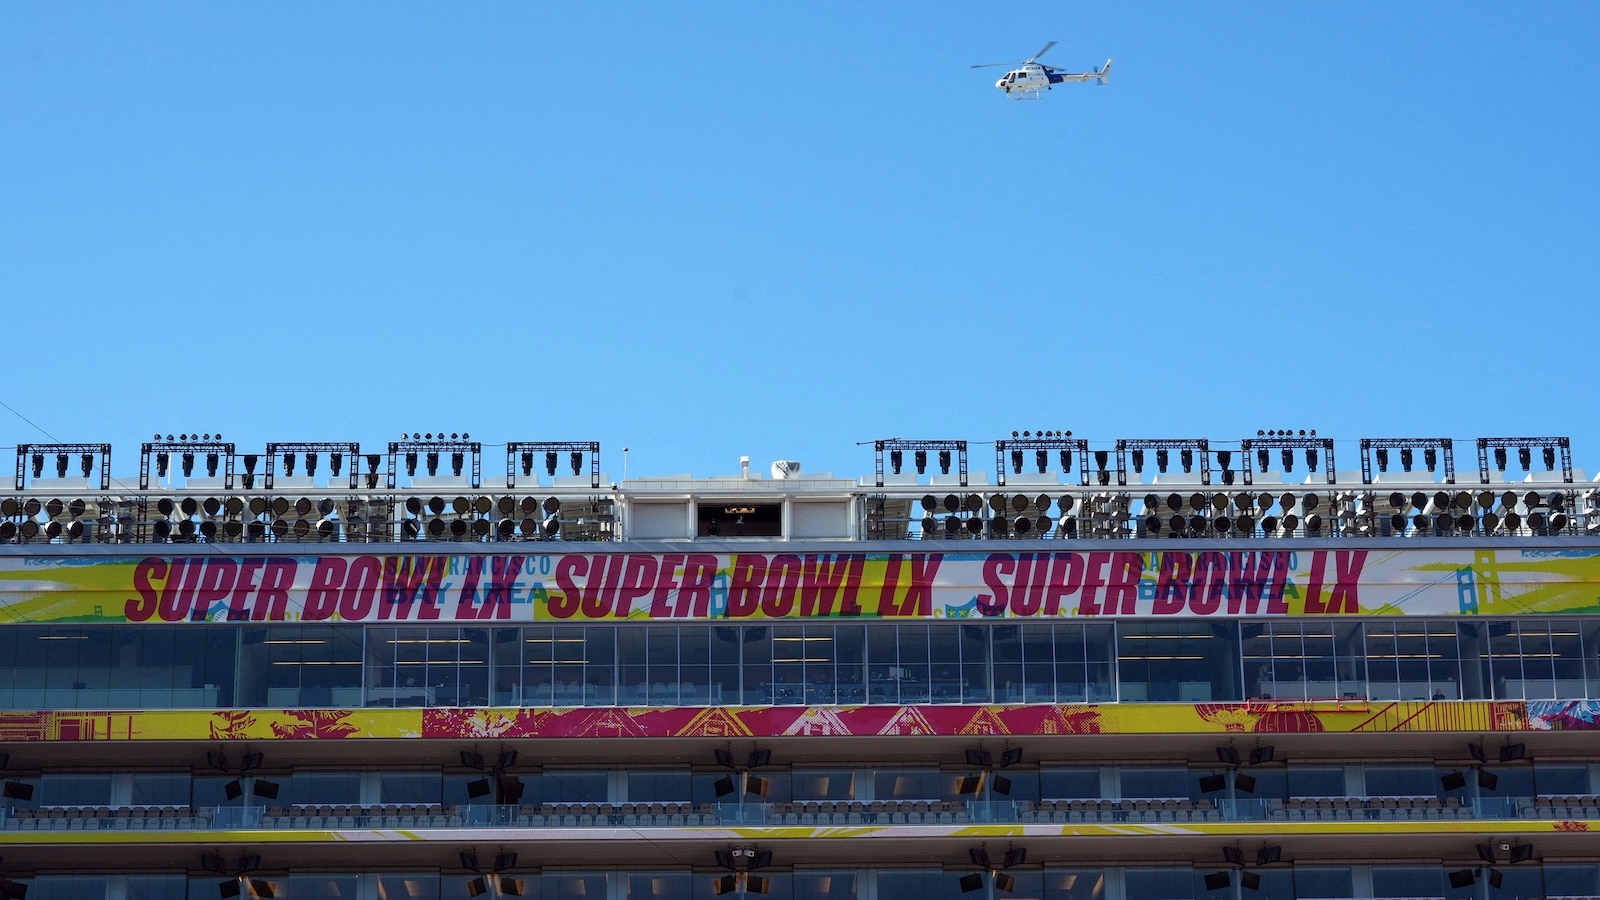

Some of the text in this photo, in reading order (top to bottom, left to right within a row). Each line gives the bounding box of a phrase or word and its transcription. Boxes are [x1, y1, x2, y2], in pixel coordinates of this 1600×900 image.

[387, 555, 550, 576] SAN FRANCISCO
[1137, 550, 1299, 572] SAN FRANCISCO
[124, 555, 526, 622] SUPER BOWL LX
[386, 582, 550, 605] BAY AREA
[547, 553, 945, 619] SUPER BOWL LX
[976, 550, 1369, 617] SUPER BOWL LX
[1137, 577, 1301, 600] BAY AREA
